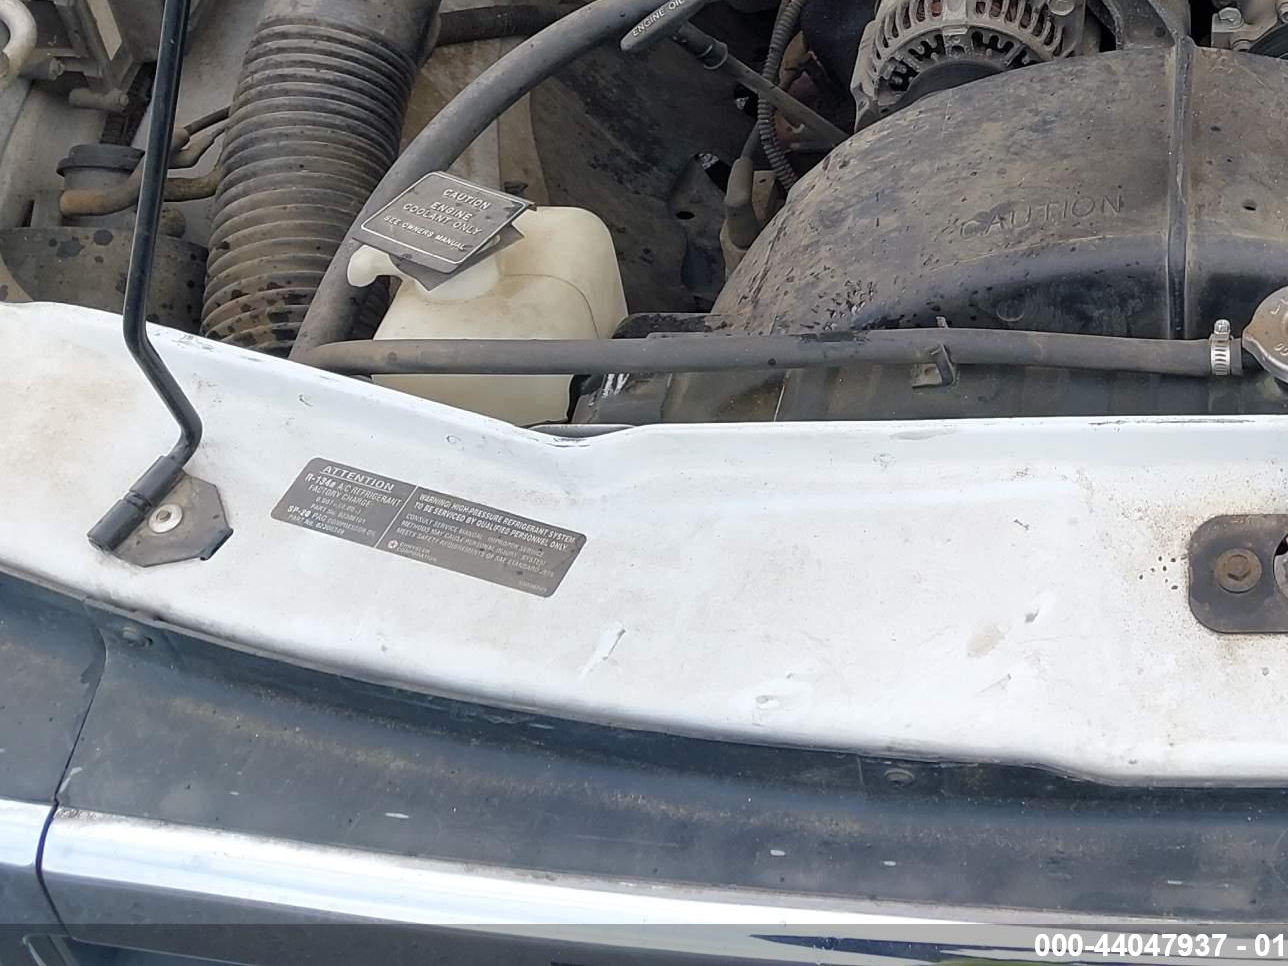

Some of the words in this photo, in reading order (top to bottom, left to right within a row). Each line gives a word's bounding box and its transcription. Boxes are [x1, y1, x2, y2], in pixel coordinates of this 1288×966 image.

[632, 8, 665, 36] ENGINE
[431, 201, 473, 221] ENGINE
[443, 189, 491, 210] CAUTION
[403, 203, 450, 225] COOLANT
[453, 221, 482, 235] ONLY
[958, 194, 1124, 237] CAUTION
[384, 215, 400, 226] SEE
[435, 234, 465, 250] MANUAL
[303, 473, 337, 488] R-134a
[349, 486, 402, 507] REFRIGERANT
[322, 464, 395, 491] ATTENTION
[307, 484, 341, 498] FACTORY
[340, 493, 372, 507] CHARGE
[286, 505, 312, 517] SP-20
[405, 513, 433, 525] CONSULT
[432, 521, 458, 532] SERVICE
[431, 507, 466, 522] SERVICED
[474, 519, 511, 534] QUALIFIED
[509, 529, 550, 546] PERSONNEL
[502, 517, 549, 535] REFRIGERANT
